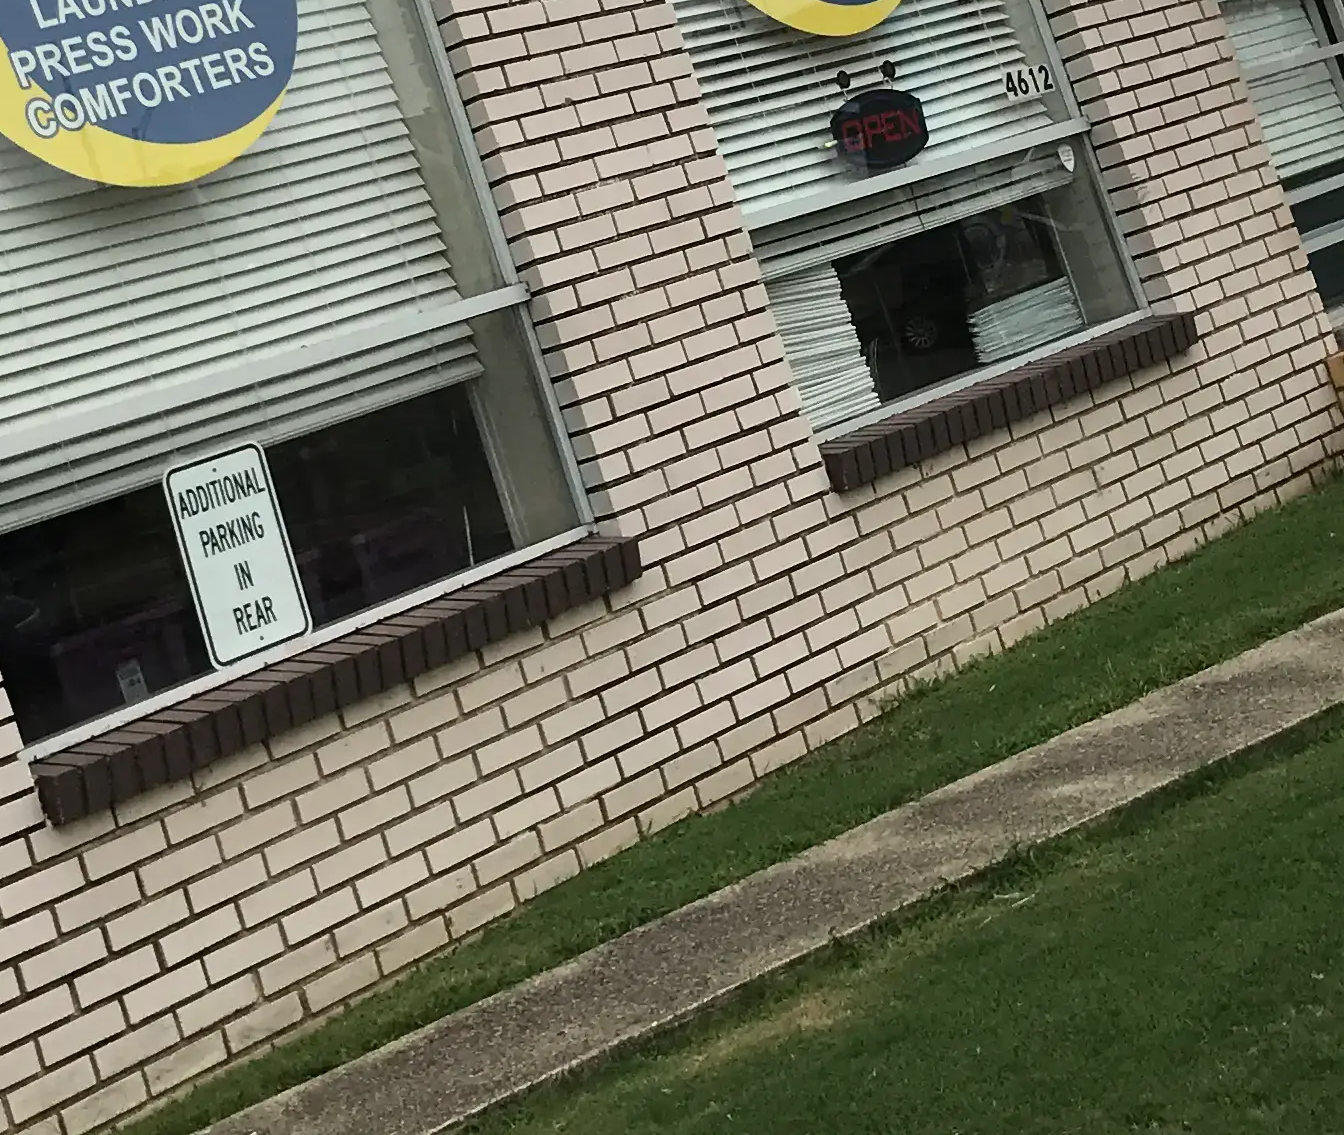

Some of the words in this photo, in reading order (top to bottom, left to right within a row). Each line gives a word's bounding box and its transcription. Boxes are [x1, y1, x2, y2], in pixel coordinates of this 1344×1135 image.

[10, 25, 138, 90] PRESS
[26, 41, 276, 139] COMFORTERS
[1004, 64, 1054, 98] 4612
[841, 107, 922, 153] OPEN
[177, 467, 266, 520] ADDITIONAL
[199, 511, 265, 558] PARKING
[233, 560, 255, 591] IN
[232, 596, 278, 635] REAR
